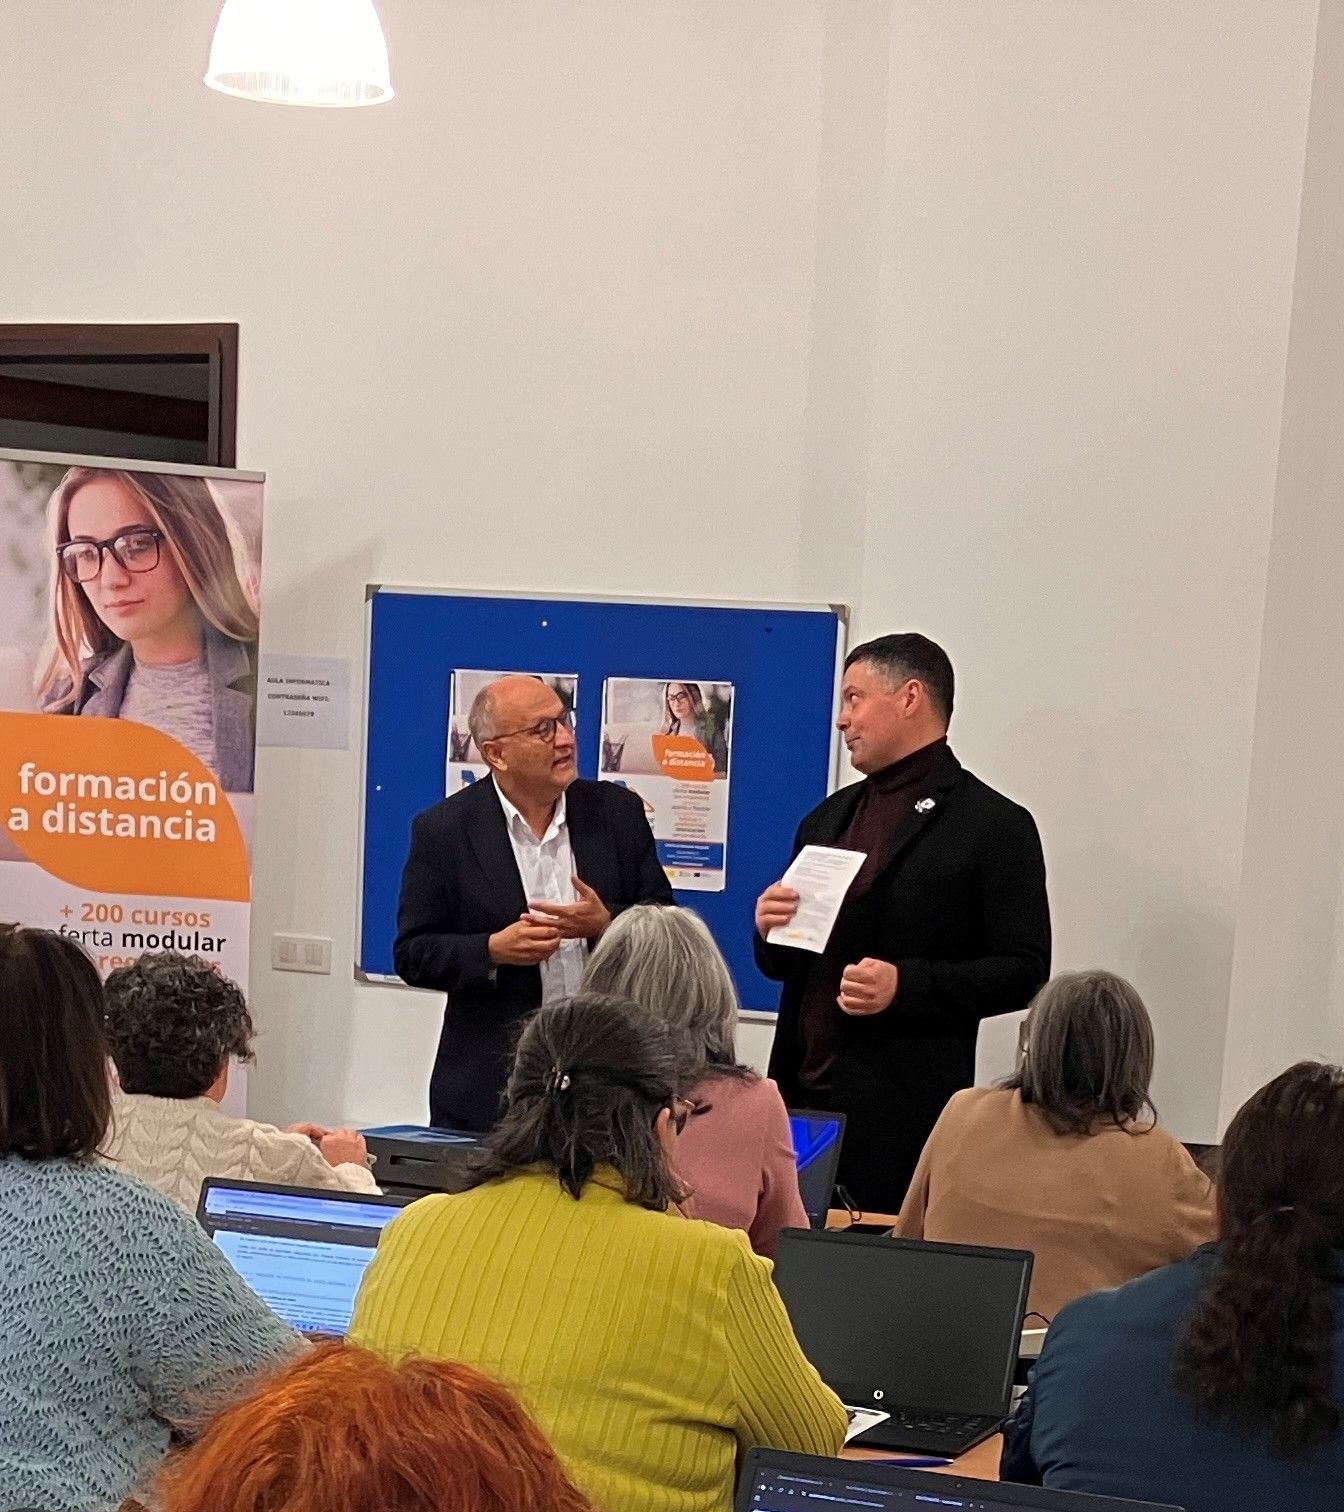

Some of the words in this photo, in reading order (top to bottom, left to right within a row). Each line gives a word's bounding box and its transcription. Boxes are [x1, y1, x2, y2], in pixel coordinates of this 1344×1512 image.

[664, 748, 707, 759] formación
[668, 758, 706, 767] distancia
[17, 761, 217, 806] formación
[7, 806, 30, 832] a
[41, 801, 217, 843] distancia
[59, 904, 74, 919] +
[80, 903, 124, 924] 200
[131, 907, 211, 928] cursos
[121, 929, 227, 953] modular
